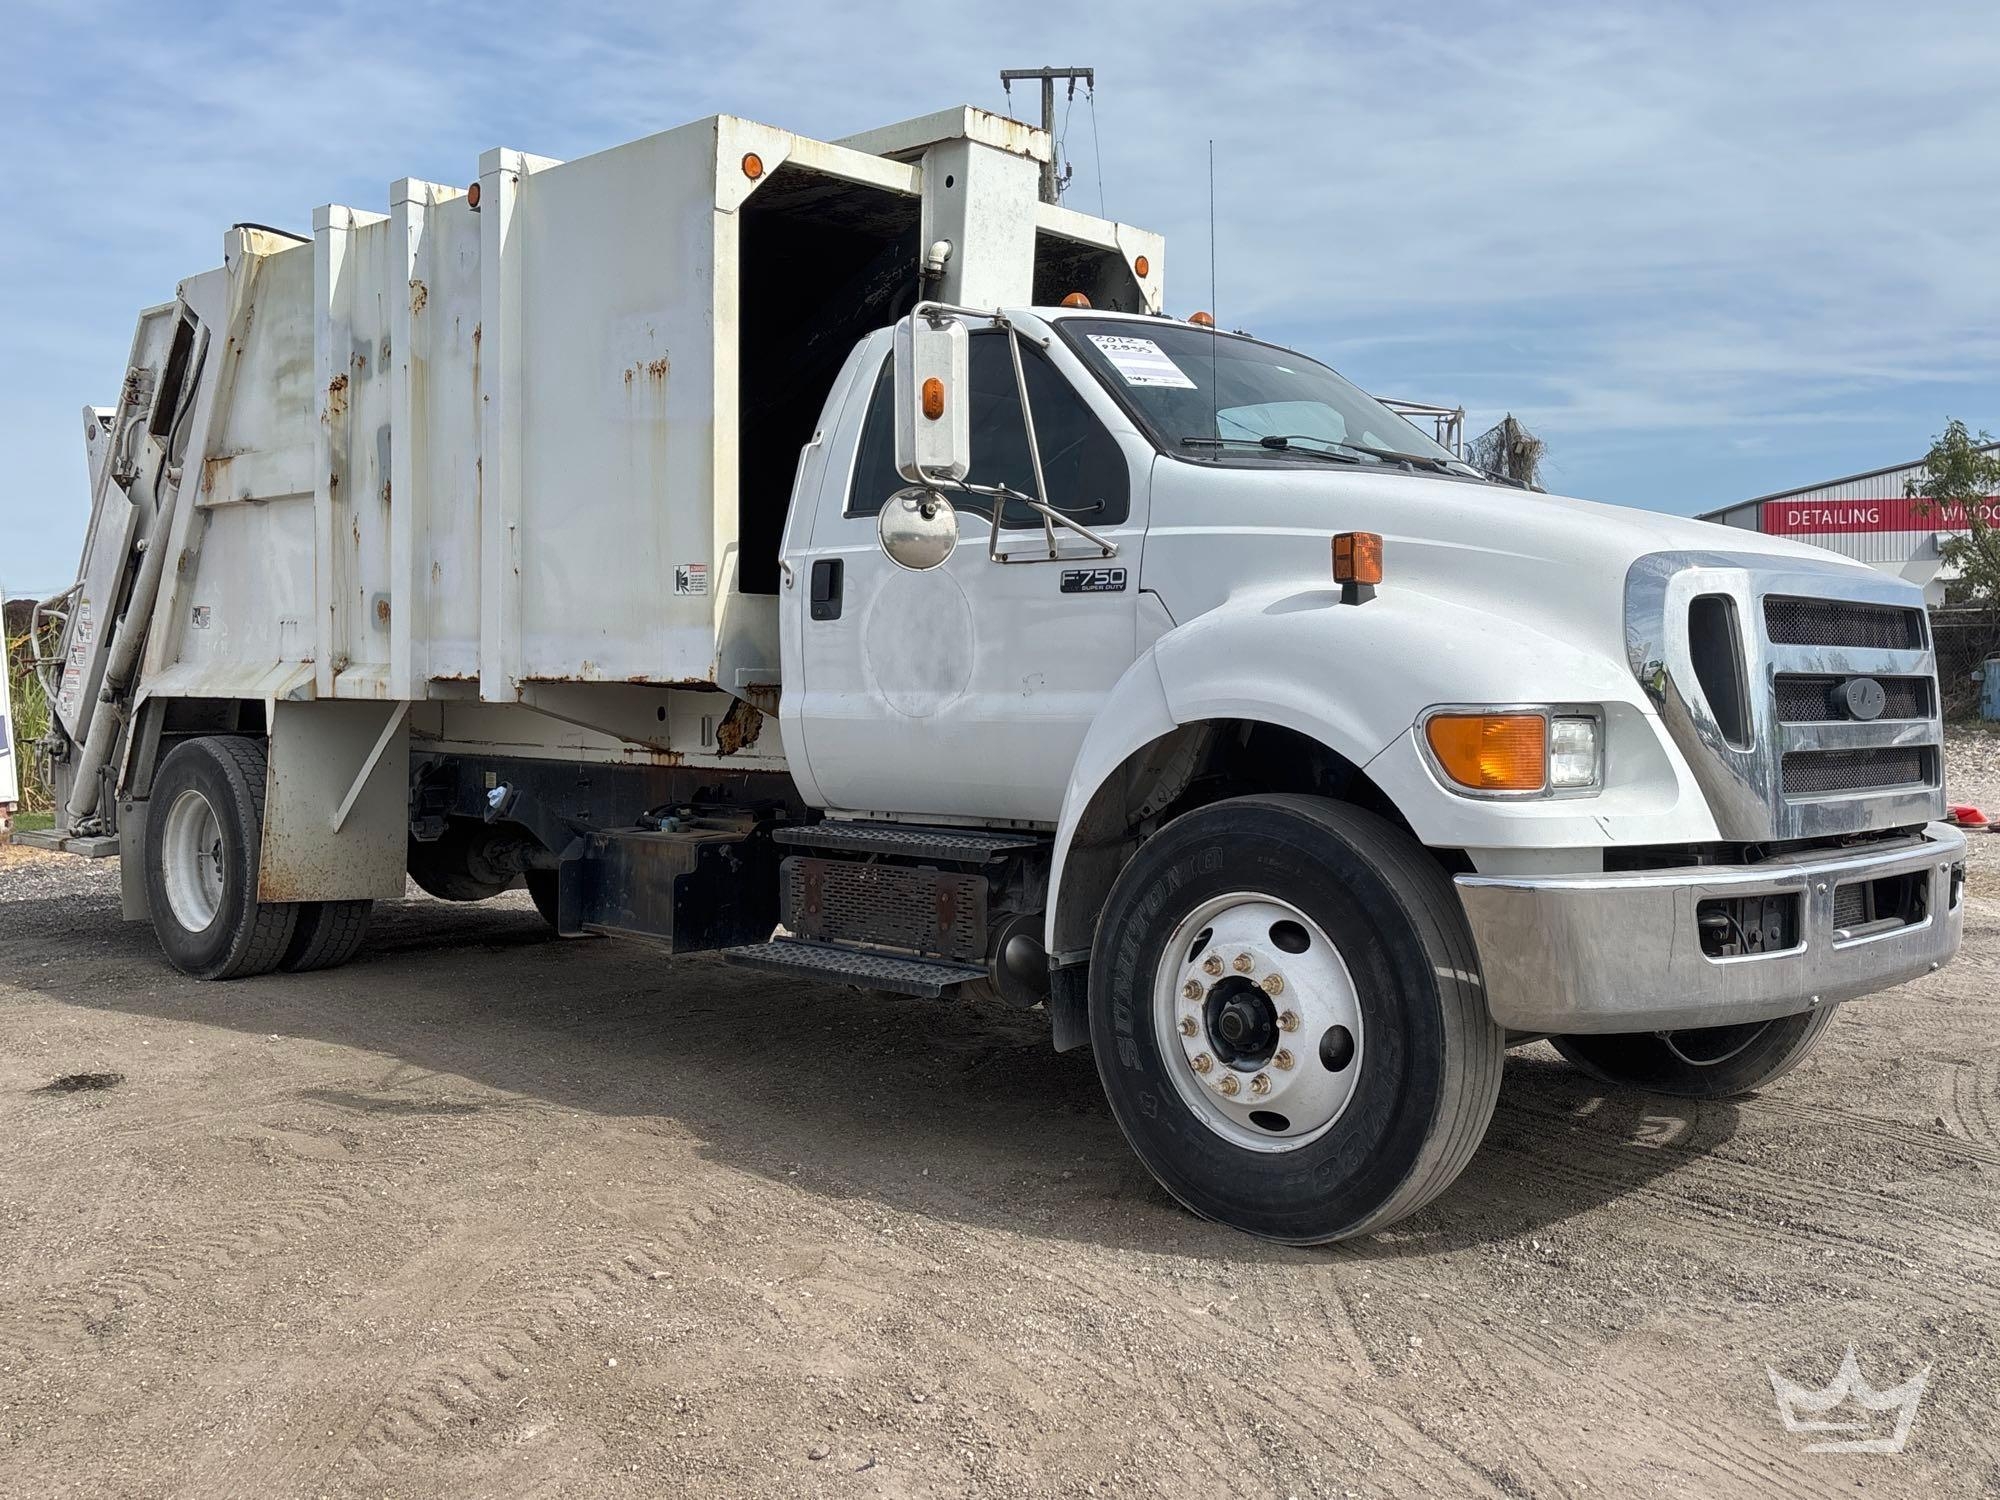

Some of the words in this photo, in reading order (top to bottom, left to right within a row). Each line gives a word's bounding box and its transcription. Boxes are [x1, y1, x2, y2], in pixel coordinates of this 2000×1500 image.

[1788, 507, 1880, 526] DETAILING
[1062, 569, 1125, 586] F-750
[1112, 846, 1224, 1072] SUMITOMO
